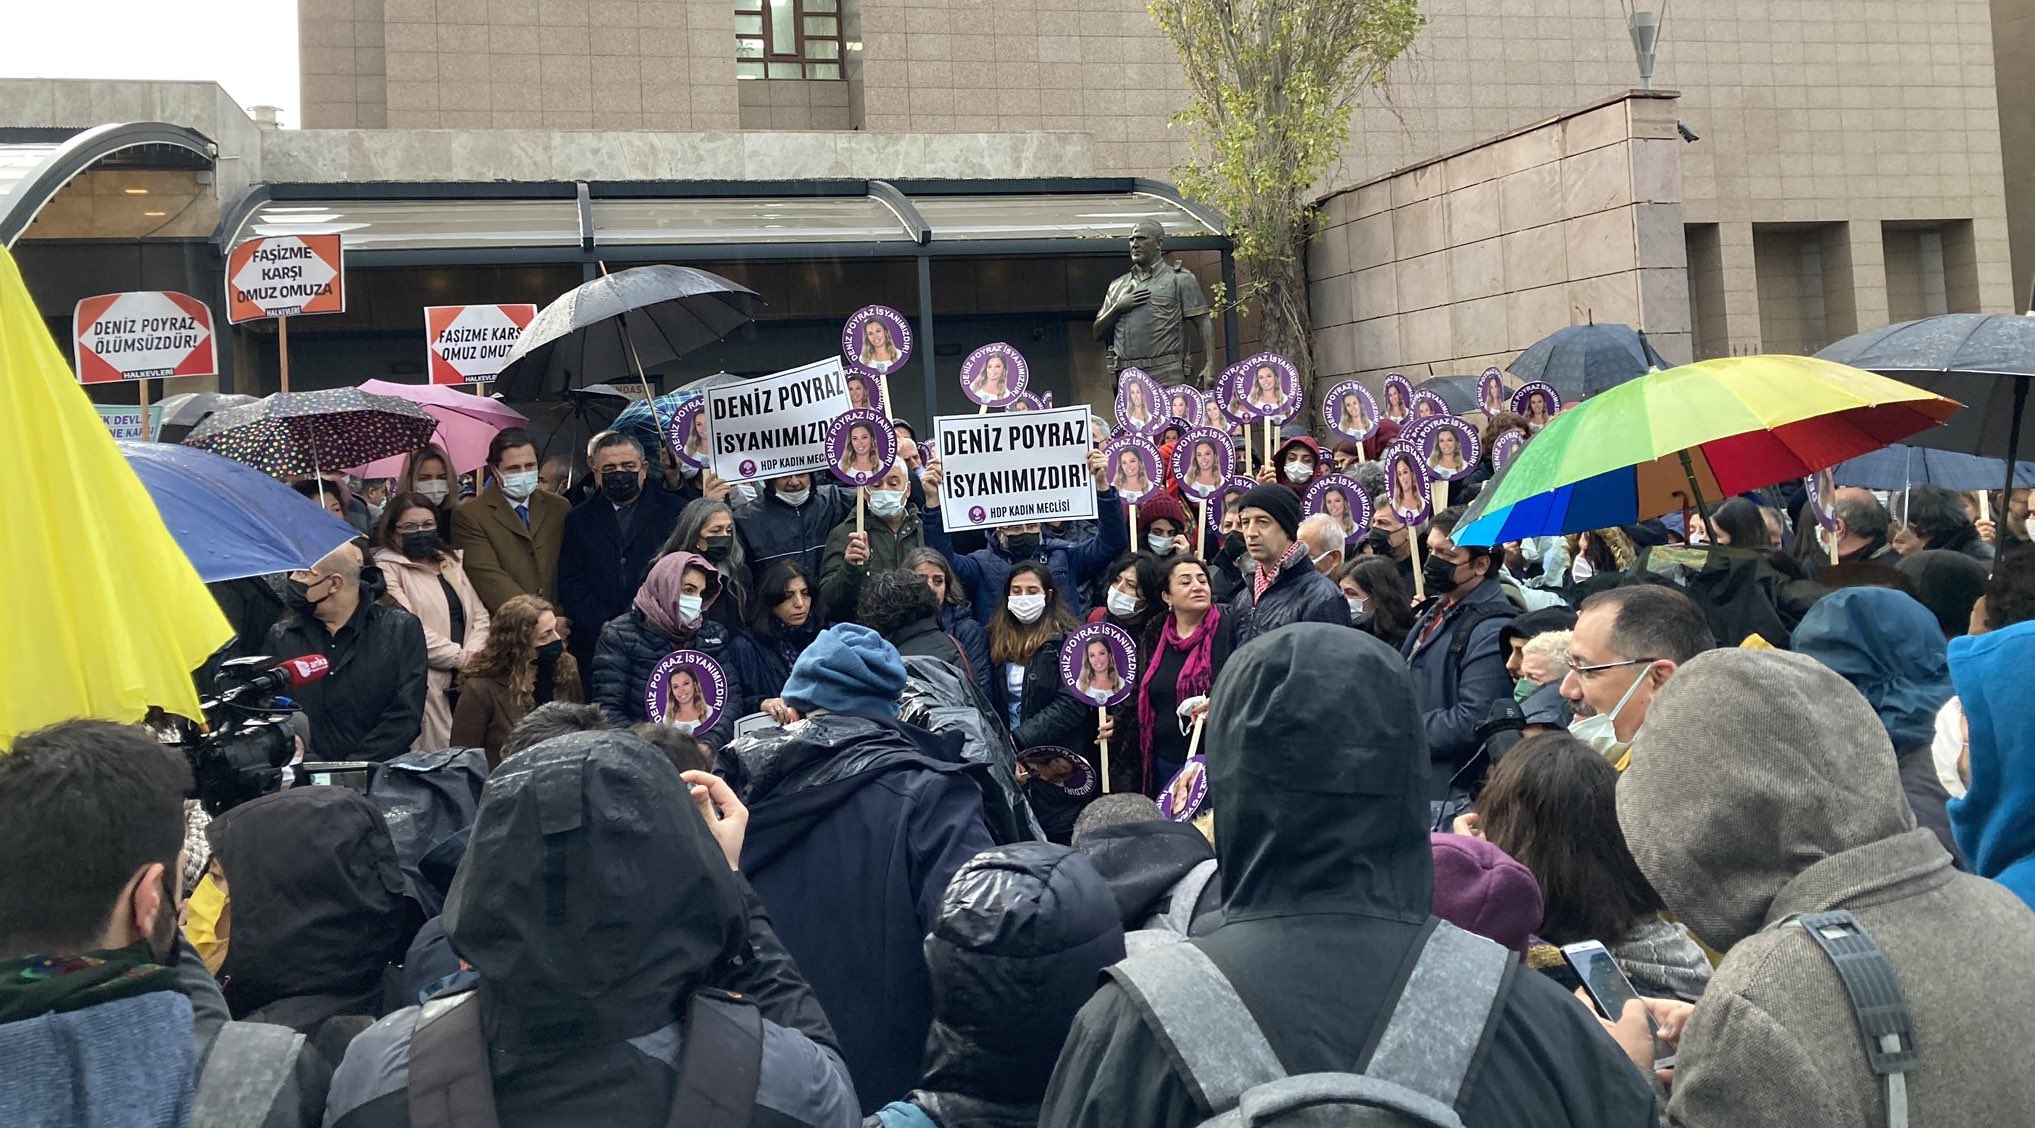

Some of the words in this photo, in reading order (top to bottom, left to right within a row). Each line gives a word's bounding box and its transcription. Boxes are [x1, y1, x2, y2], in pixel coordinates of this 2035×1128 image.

[252, 245, 313, 264] FAŞİZME
[262, 266, 302, 281] KARŞI
[237, 286, 278, 303] OMUZ
[280, 283, 333, 298] OMUZA
[94, 317, 137, 336] DENİZ
[141, 317, 196, 332] POYRAZ
[846, 308, 875, 335] POYRAZ
[95, 332, 198, 354] ÖLÜMSÜZDÜR!
[439, 326, 489, 346] FAŞİZME
[442, 346, 477, 361] OMUZ
[480, 344, 514, 359] OMUZ
[844, 336, 858, 361] DENİZ
[970, 345, 1003, 362] POYRAZ
[123, 368, 174, 379] HALKEVLERİ
[1239, 354, 1268, 376] POYRAZ
[713, 388, 774, 421] DENİZ
[778, 369, 844, 411] POYRAZ
[1216, 386, 1227, 410] DENİZ
[1235, 376, 1247, 400] DENİZ
[1326, 382, 1352, 406] POYRAZ
[1515, 383, 1541, 400] POYRAZ
[830, 411, 865, 436] POYRAZ
[1420, 418, 1450, 438] POYRAZ
[669, 423, 683, 452] DENİZ
[716, 417, 833, 456] İSYANIMIZD
[943, 423, 1003, 456] DENİZ
[1009, 419, 1086, 451] POYRAZ
[1105, 438, 1131, 457] OYRAZ
[826, 436, 838, 466] DENİZ
[1172, 452, 1184, 480] DENİZ
[1178, 429, 1208, 452] POYRAZ
[761, 459, 778, 471] HDP
[780, 456, 805, 469] KADIN
[945, 463, 1088, 499] İSYANIMIZDIR!
[1306, 476, 1338, 500] POYRAZ
[990, 506, 1007, 519] HDP
[1009, 504, 1035, 517] KADIN
[1036, 499, 1070, 514] MECLİSİ
[1065, 625, 1100, 654] POYRAZ
[650, 655, 684, 689] POYRAZ
[1060, 654, 1076, 686] DENİZ
[646, 691, 663, 724] DENİZ
